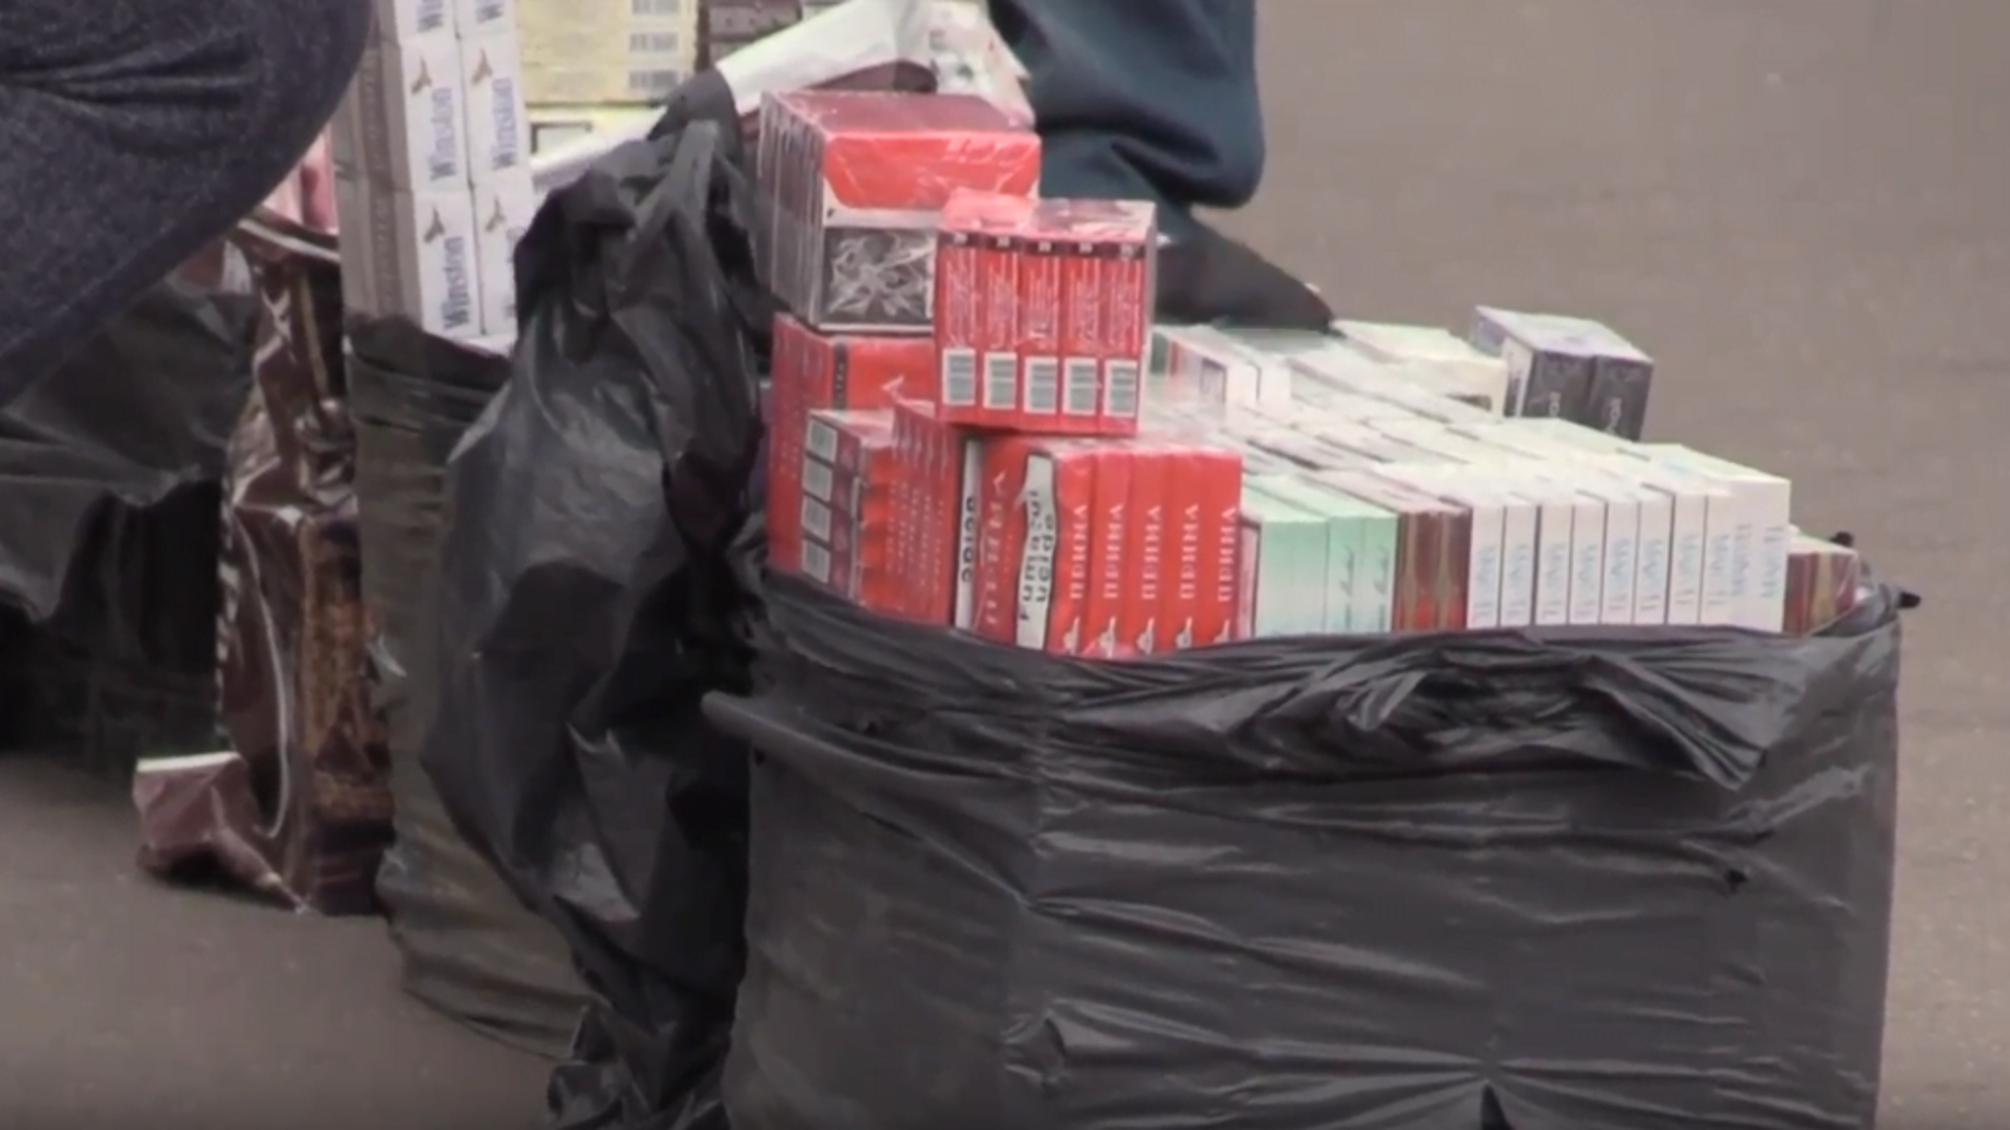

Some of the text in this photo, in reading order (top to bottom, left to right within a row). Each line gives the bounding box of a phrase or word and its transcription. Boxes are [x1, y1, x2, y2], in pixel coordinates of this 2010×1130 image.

[427, 87, 458, 181] Winston
[489, 77, 518, 171] Winston
[441, 236, 471, 329] Winston
